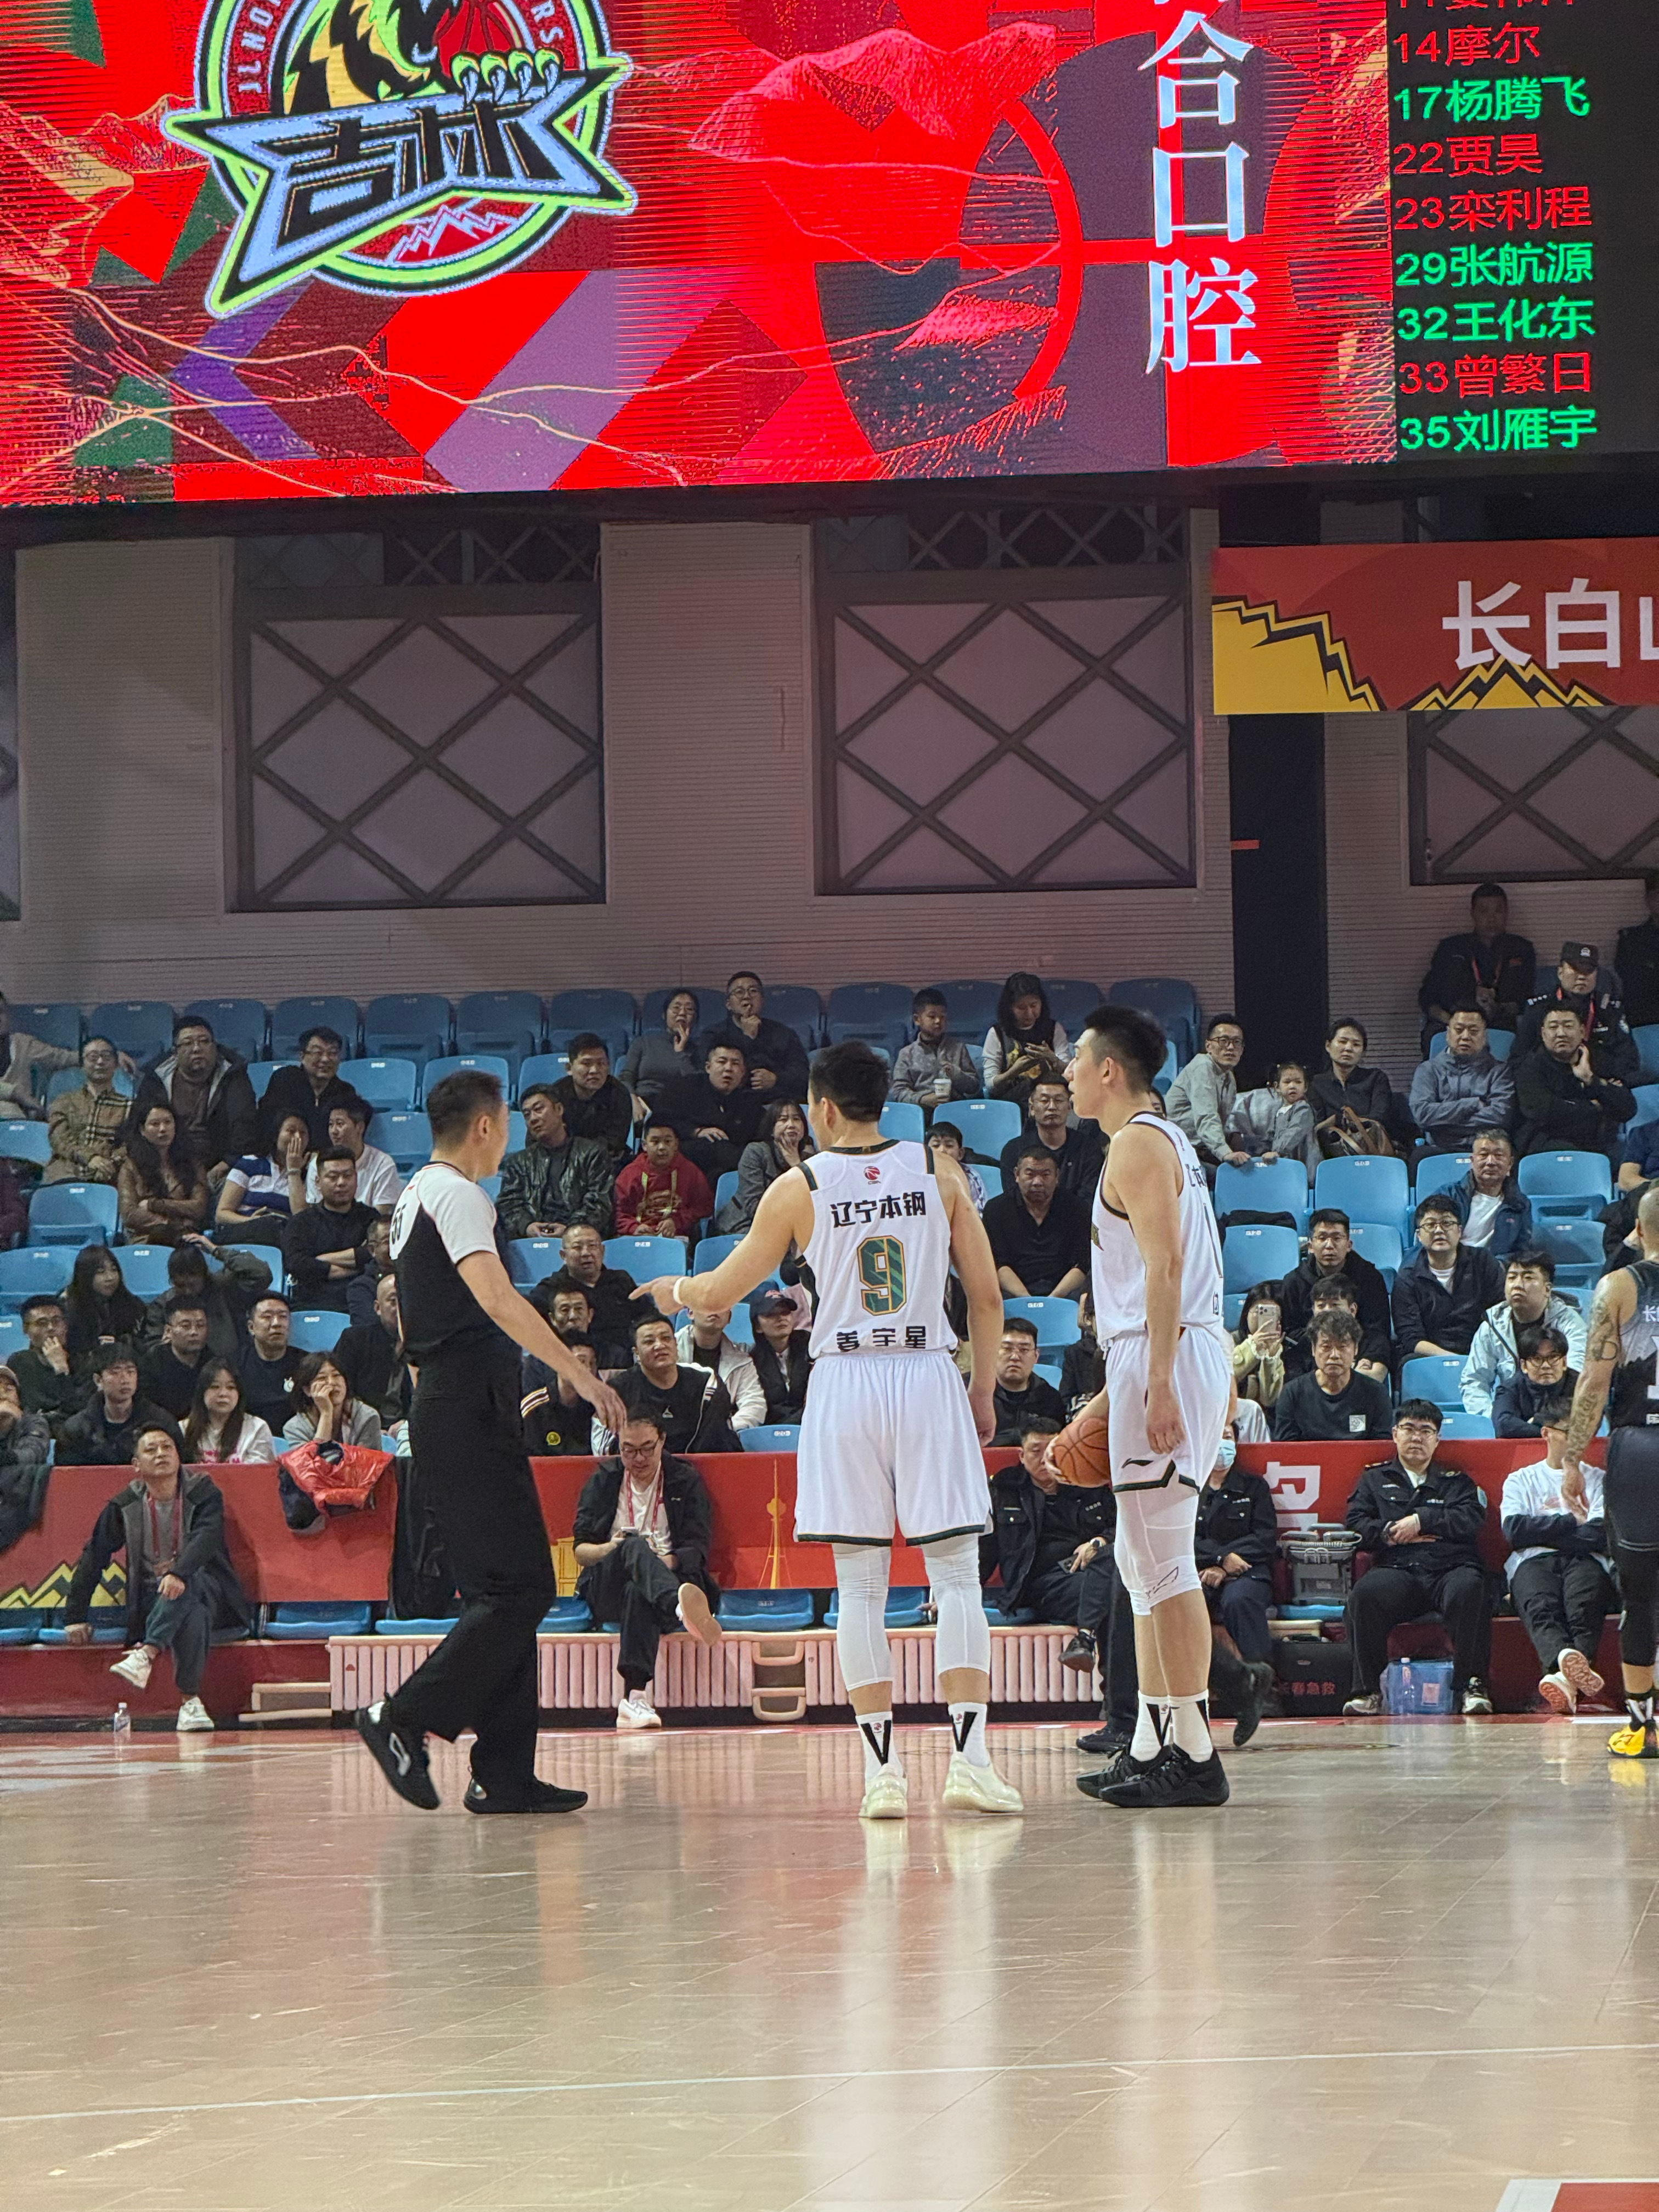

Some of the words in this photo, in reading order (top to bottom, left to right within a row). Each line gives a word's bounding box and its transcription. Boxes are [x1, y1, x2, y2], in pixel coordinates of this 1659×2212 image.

[1137, 0, 1262, 375] 合口腔
[830, 1191, 927, 1228] 辽宁本钢
[856, 1234, 907, 1317] 9
